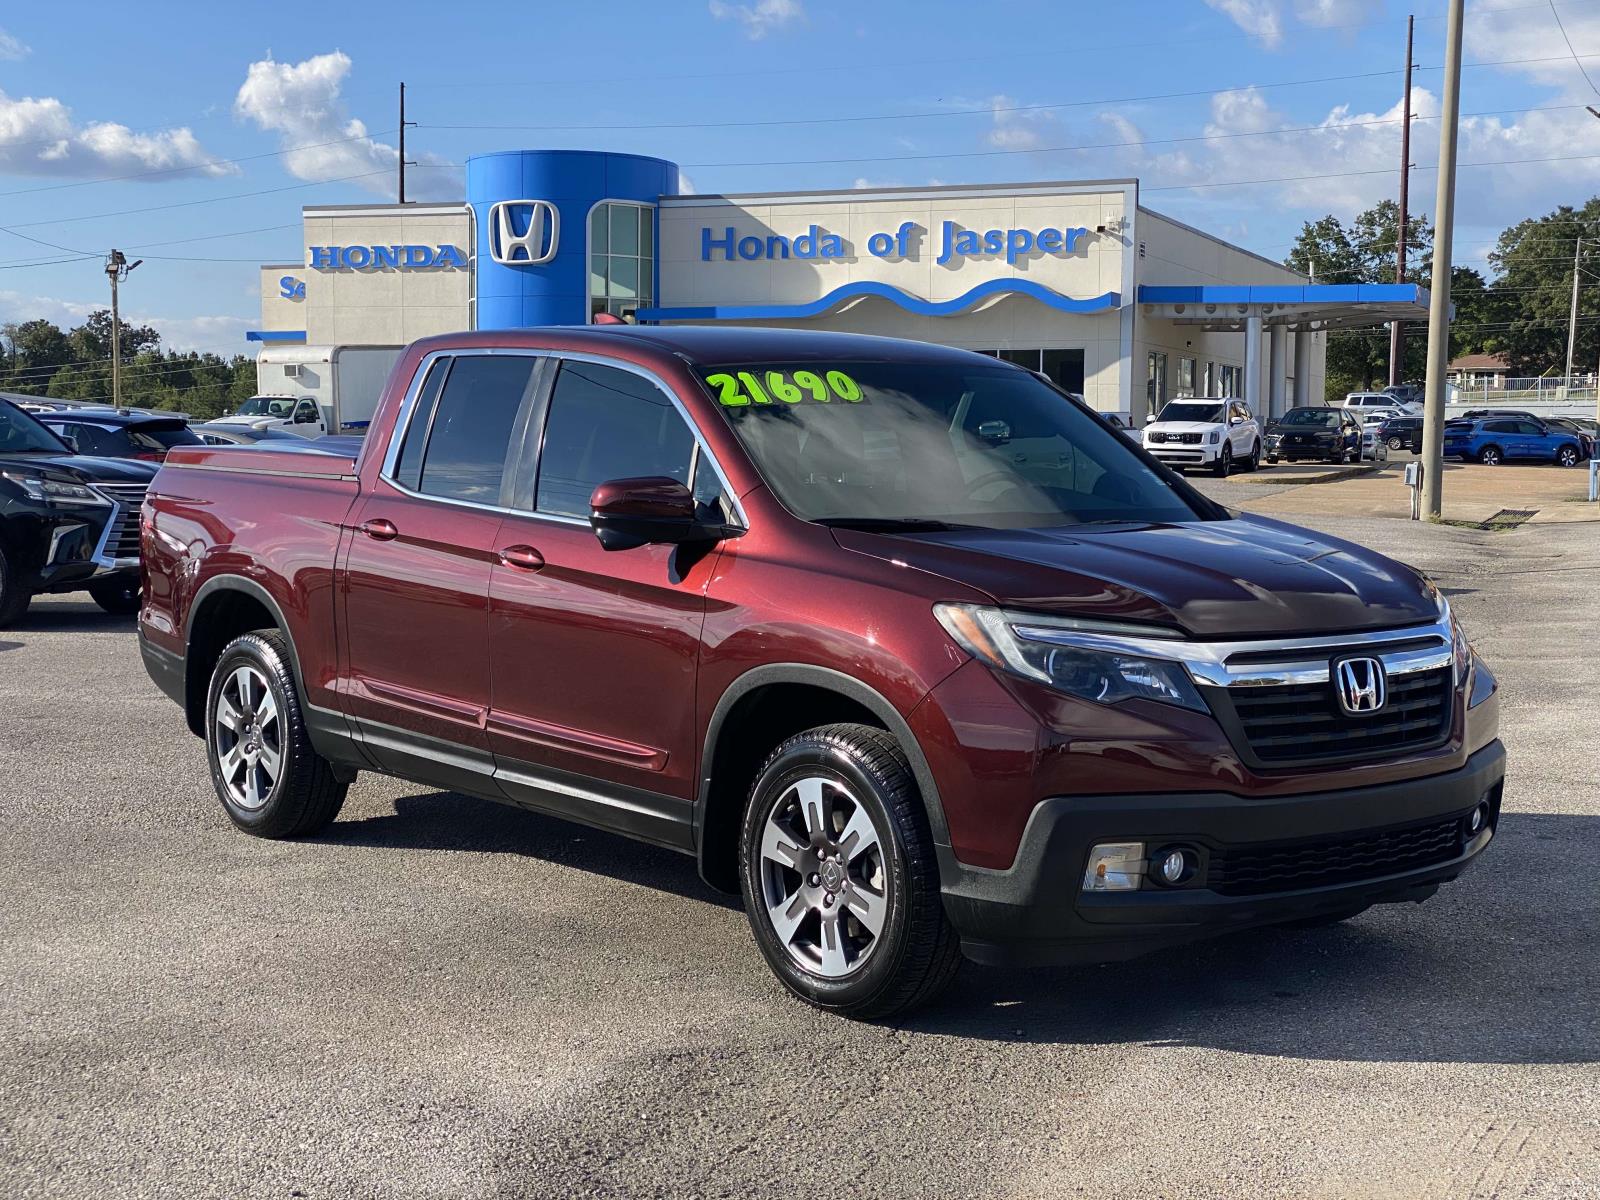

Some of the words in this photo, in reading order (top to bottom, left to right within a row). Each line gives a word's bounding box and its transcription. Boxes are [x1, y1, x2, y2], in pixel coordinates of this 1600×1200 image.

[309, 244, 468, 269] HONDA
[702, 224, 844, 262] Honda
[868, 221, 914, 257] of
[936, 220, 1087, 265] Jasper
[705, 370, 864, 407] 21690
